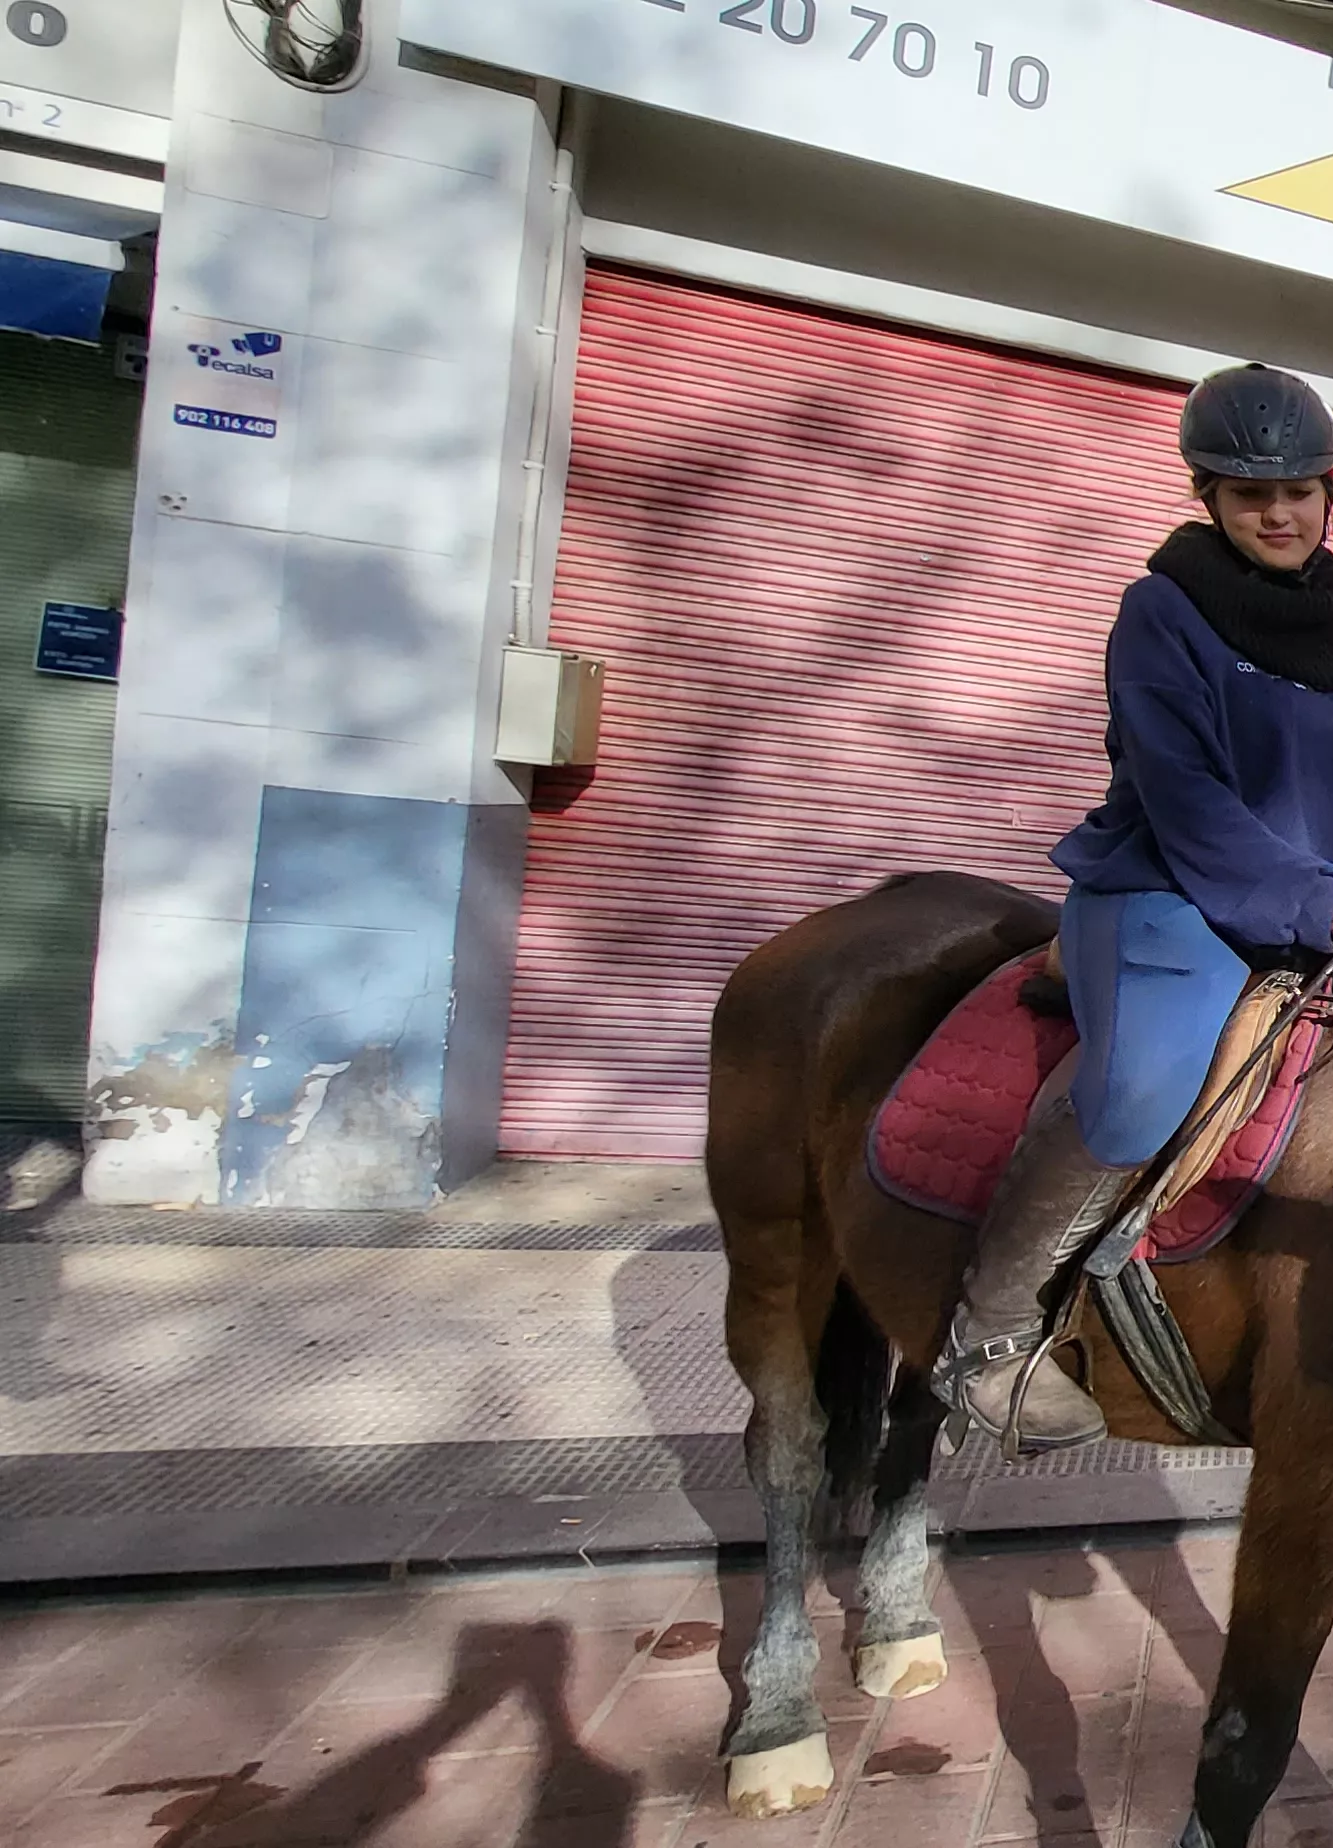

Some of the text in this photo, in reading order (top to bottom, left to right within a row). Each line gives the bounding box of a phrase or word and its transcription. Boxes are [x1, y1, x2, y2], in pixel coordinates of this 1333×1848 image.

[848, 5, 936, 78] 70
[975, 41, 1049, 110] 10
[177, 409, 209, 424] 902
[213, 415, 241, 429] 116
